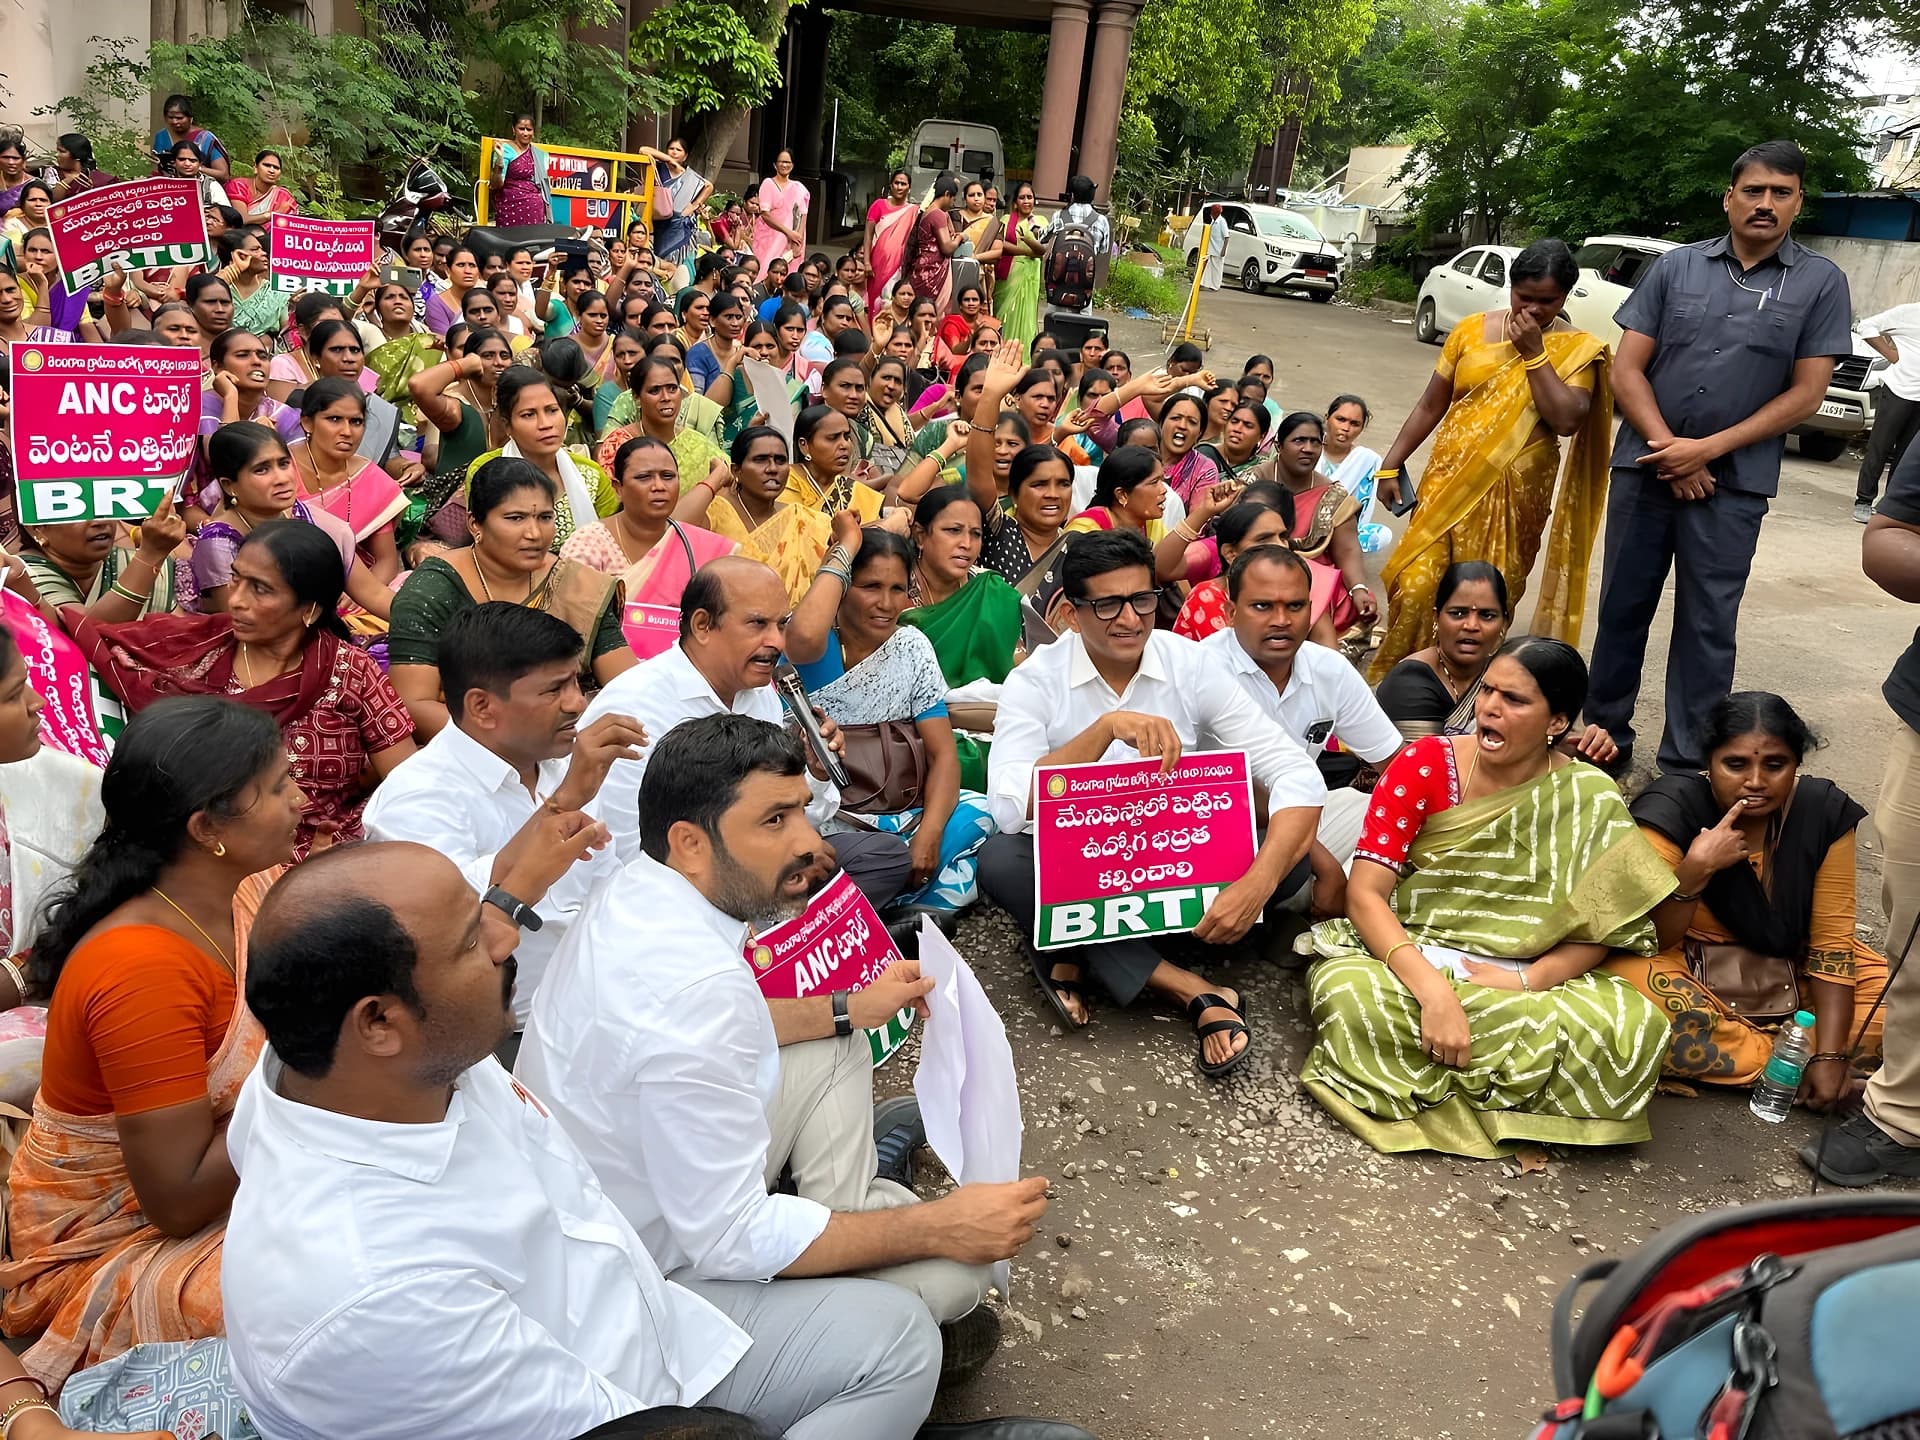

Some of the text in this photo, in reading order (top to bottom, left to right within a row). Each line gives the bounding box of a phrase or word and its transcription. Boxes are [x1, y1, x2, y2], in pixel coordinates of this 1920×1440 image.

[284, 234, 313, 251] BLO
[72, 244, 204, 289] BRTU
[58, 382, 191, 423] ANC టార్గెట్
[28, 429, 113, 464] వెంటనే
[1172, 791, 1232, 819] పెట్టిన
[1081, 826, 1211, 861] ఉద్యోగ భద్రత
[1098, 861, 1194, 892] కల్పించాలి
[794, 937, 840, 998] ANC
